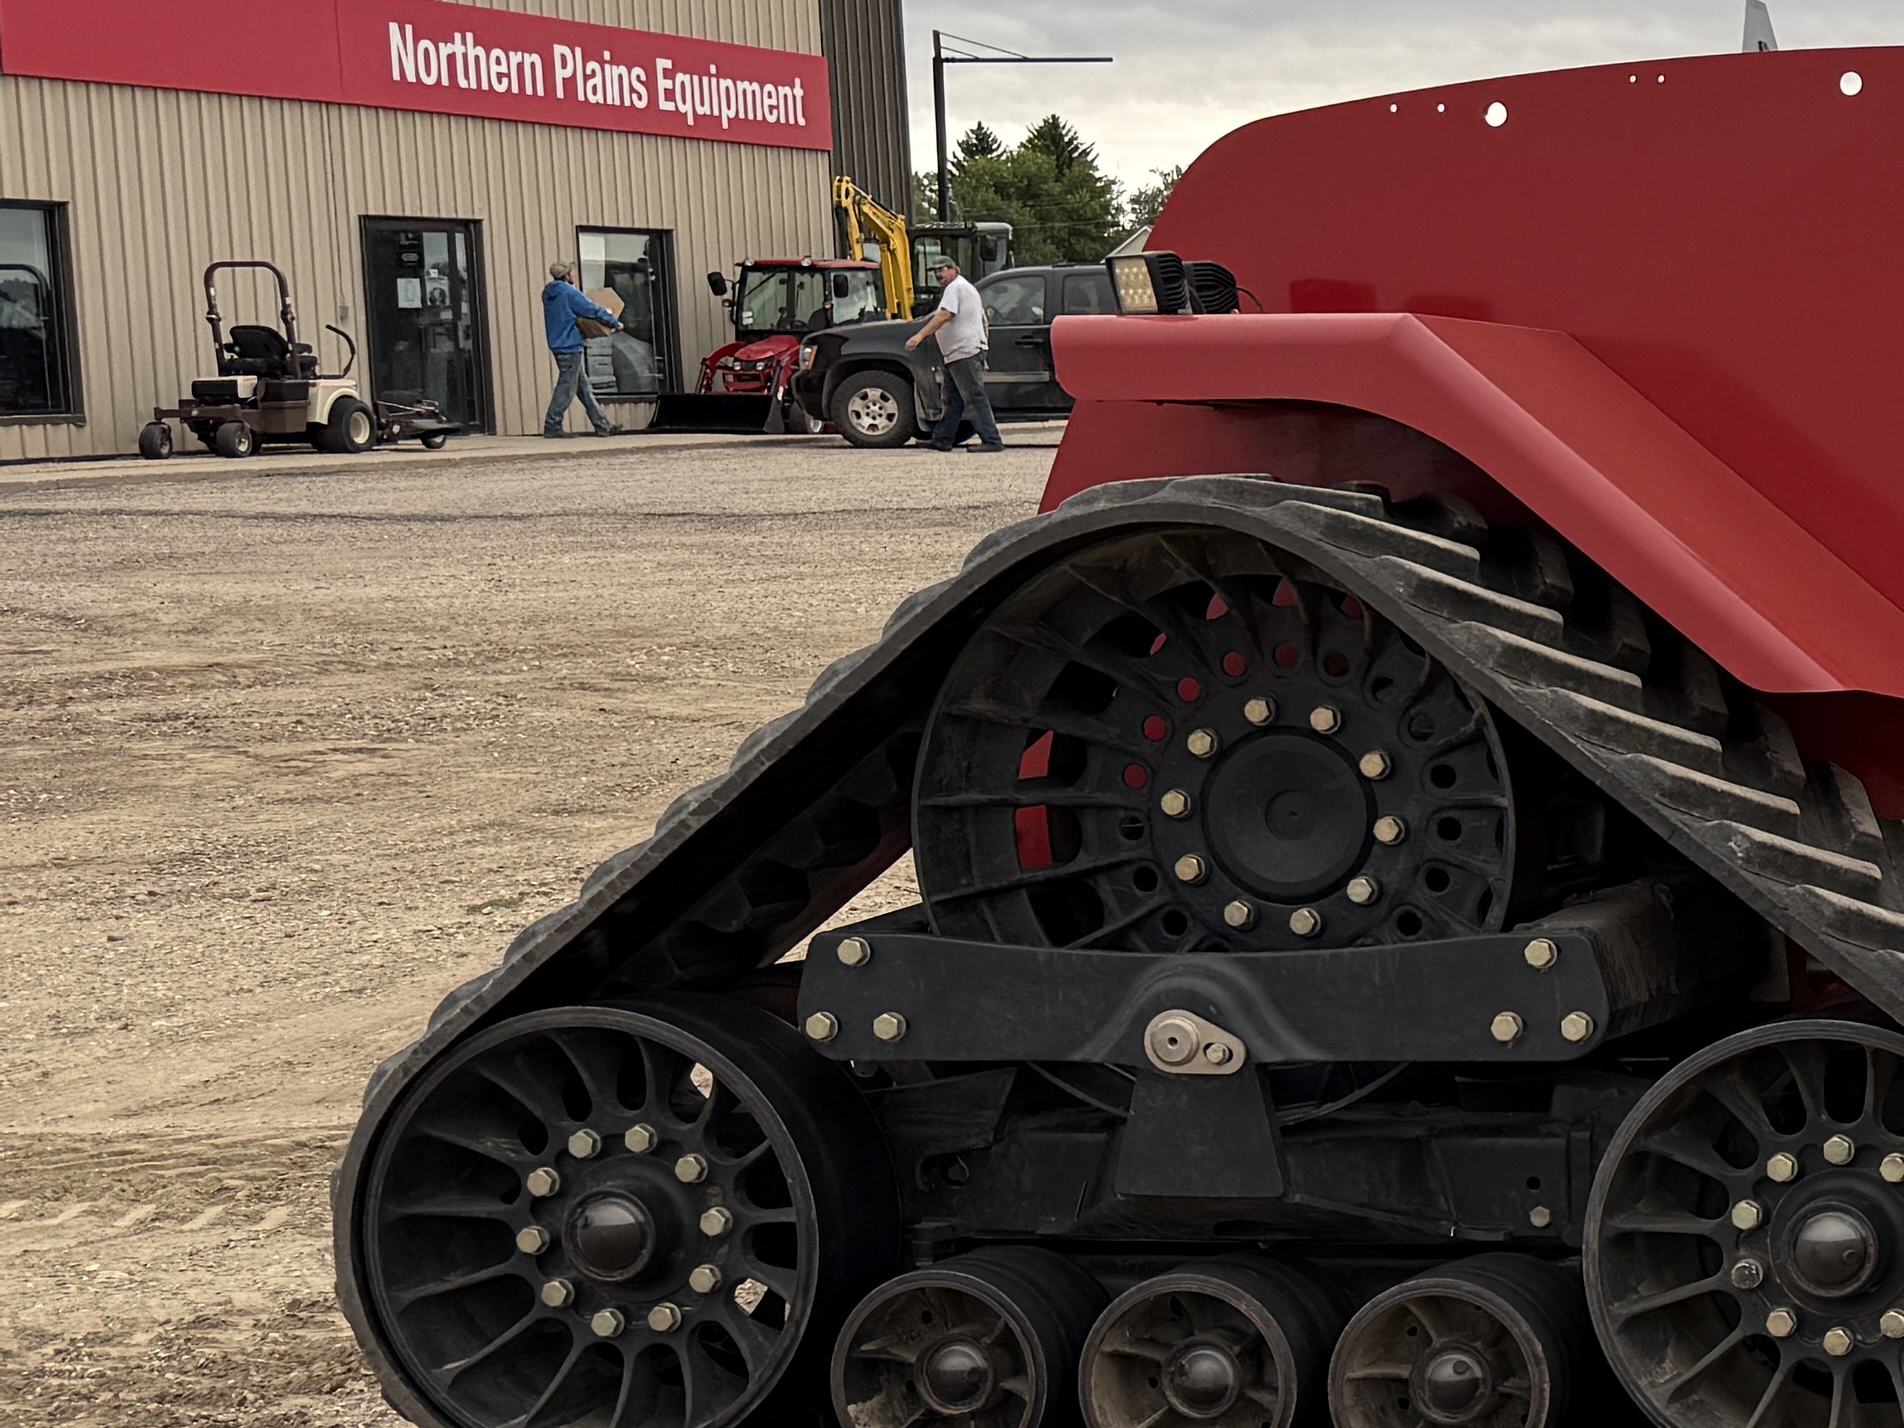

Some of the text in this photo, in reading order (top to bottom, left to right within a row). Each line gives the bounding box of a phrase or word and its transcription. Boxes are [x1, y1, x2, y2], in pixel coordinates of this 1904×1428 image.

[388, 22, 806, 129] Northern Plains Equipment
